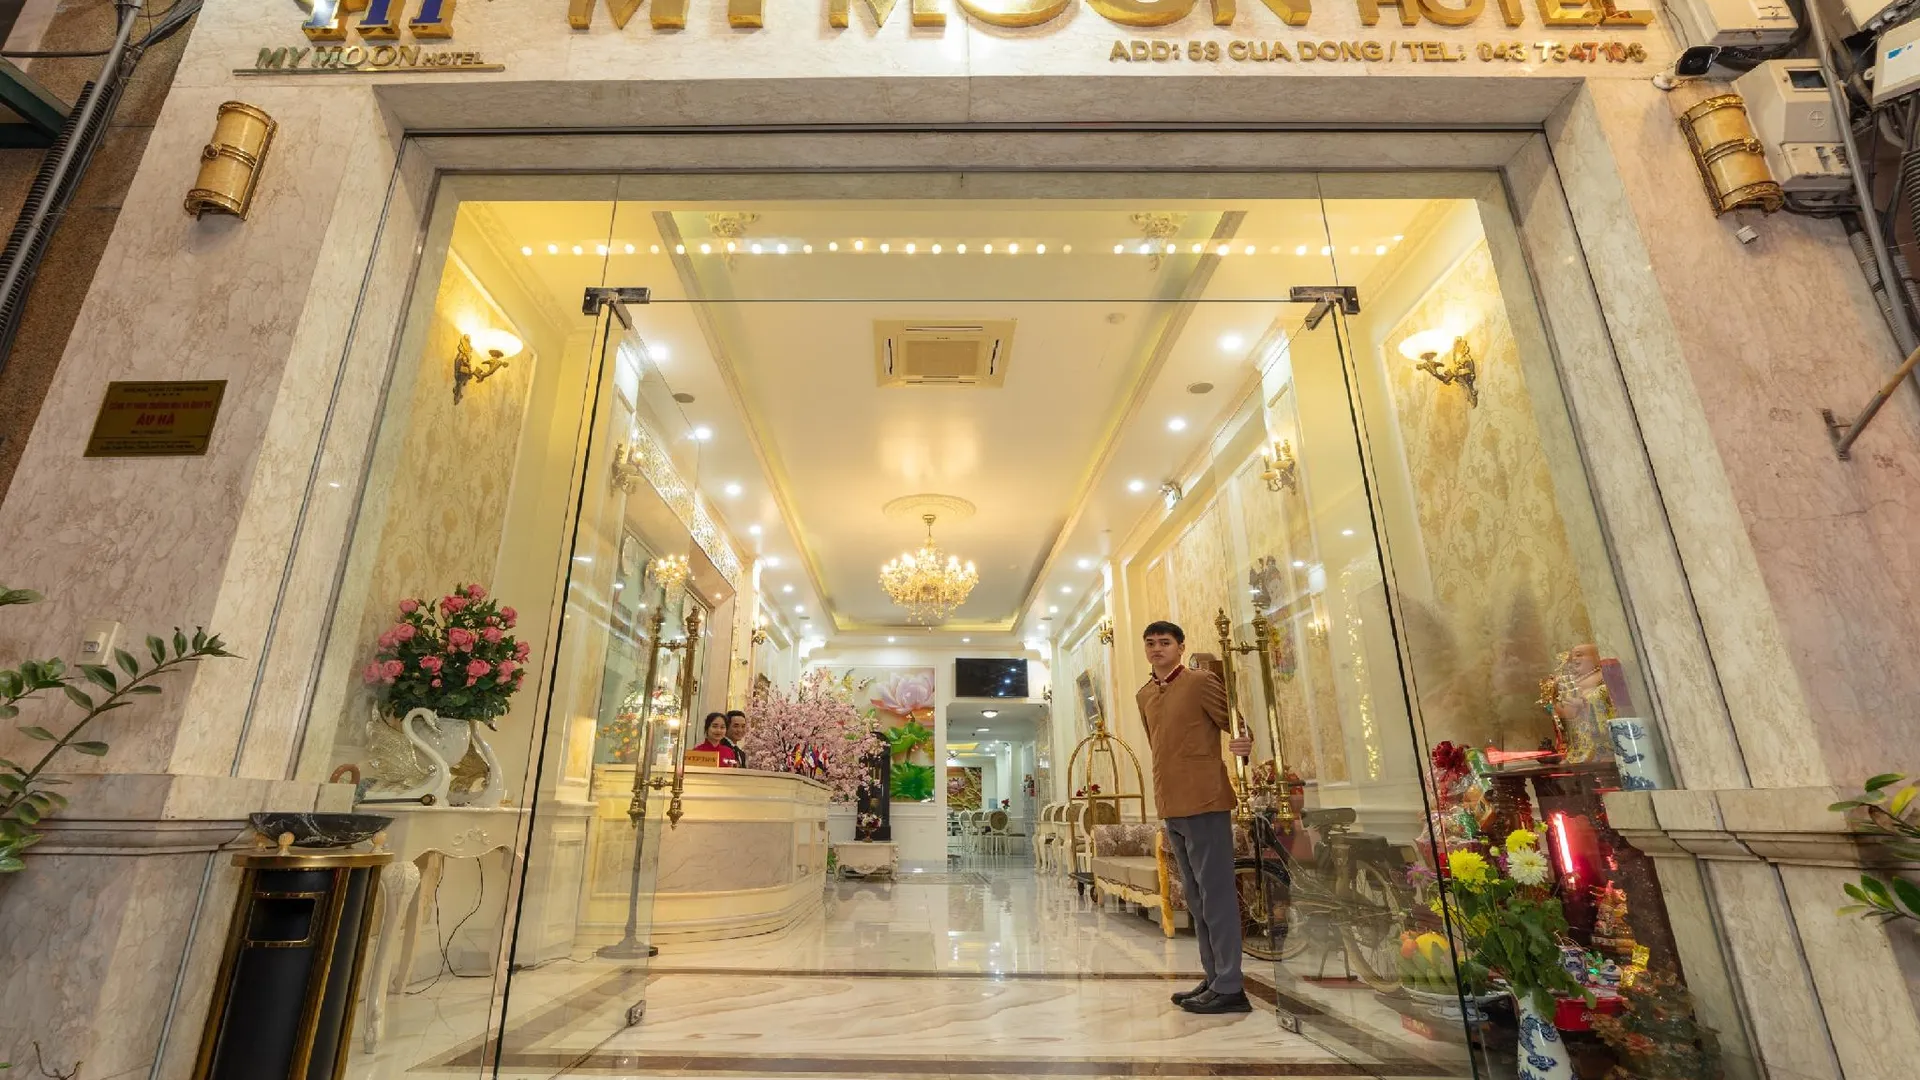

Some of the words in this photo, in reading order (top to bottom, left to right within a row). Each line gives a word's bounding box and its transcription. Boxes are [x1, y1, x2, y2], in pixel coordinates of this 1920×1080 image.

[255, 47, 310, 68] MY
[311, 46, 421, 68] MOON
[422, 52, 484, 66] HOTEL
[1109, 40, 1180, 62] ADD:
[1187, 41, 1221, 62] 59
[1228, 41, 1293, 62] CUA
[1297, 41, 1383, 62] DONG
[1402, 41, 1467, 62] TEL:
[1476, 41, 1528, 62] 043
